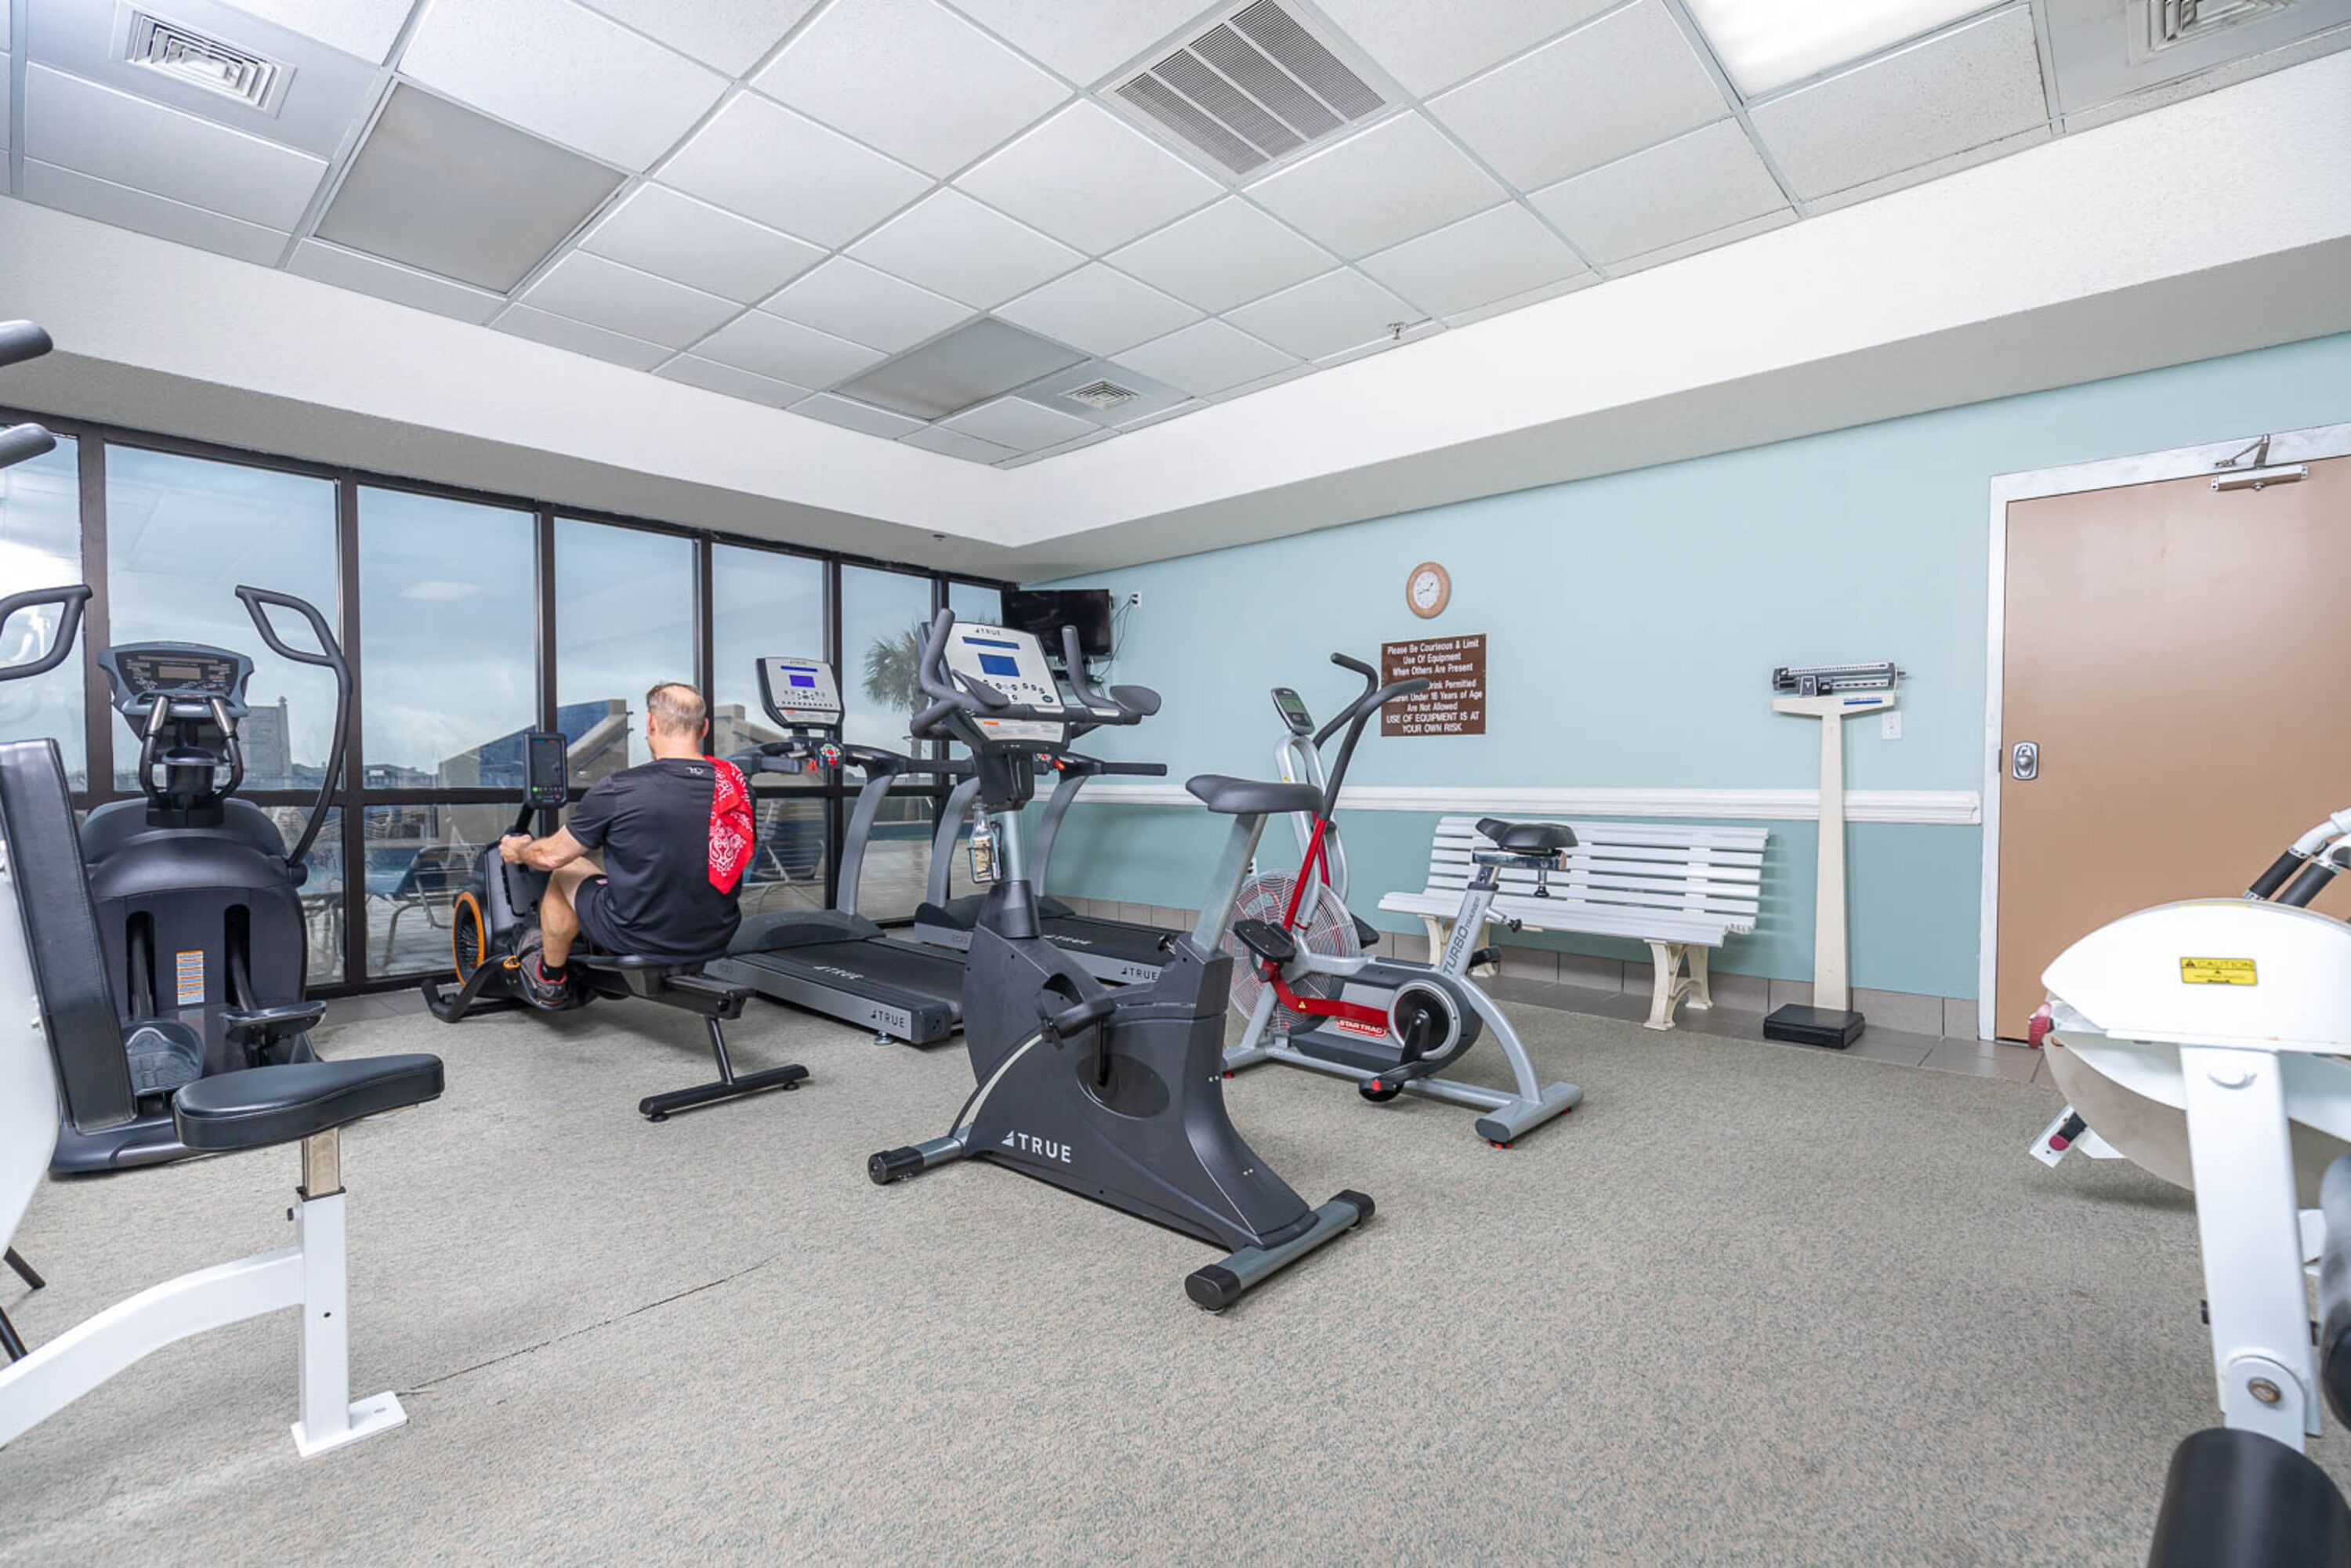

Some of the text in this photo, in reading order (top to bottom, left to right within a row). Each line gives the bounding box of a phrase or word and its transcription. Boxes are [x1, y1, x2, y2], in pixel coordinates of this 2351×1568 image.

[1387, 639, 1479, 655] Please Be Courteous & Limit
[1403, 652, 1462, 664] Use Of Equipment
[1393, 662, 1473, 677] When Others Are Present
[1445, 679, 1476, 689] Permitted
[1410, 692, 1429, 702] Under
[1440, 690, 1458, 700] Years
[1459, 690, 1467, 699] of
[1469, 690, 1483, 700] Age
[1407, 701, 1458, 712] Are Not Allowed
[1386, 710, 1480, 724] USE OF EQUIPMENT IS AT
[1402, 722, 1463, 733] YOUR OWN RISK
[1443, 925, 1469, 976] TURBO
[1130, 967, 1158, 980] TRUE
[878, 1009, 905, 1028] TRUE
[1339, 1019, 1383, 1034] STAR TRAC
[1017, 1132, 1071, 1164] TRUE
